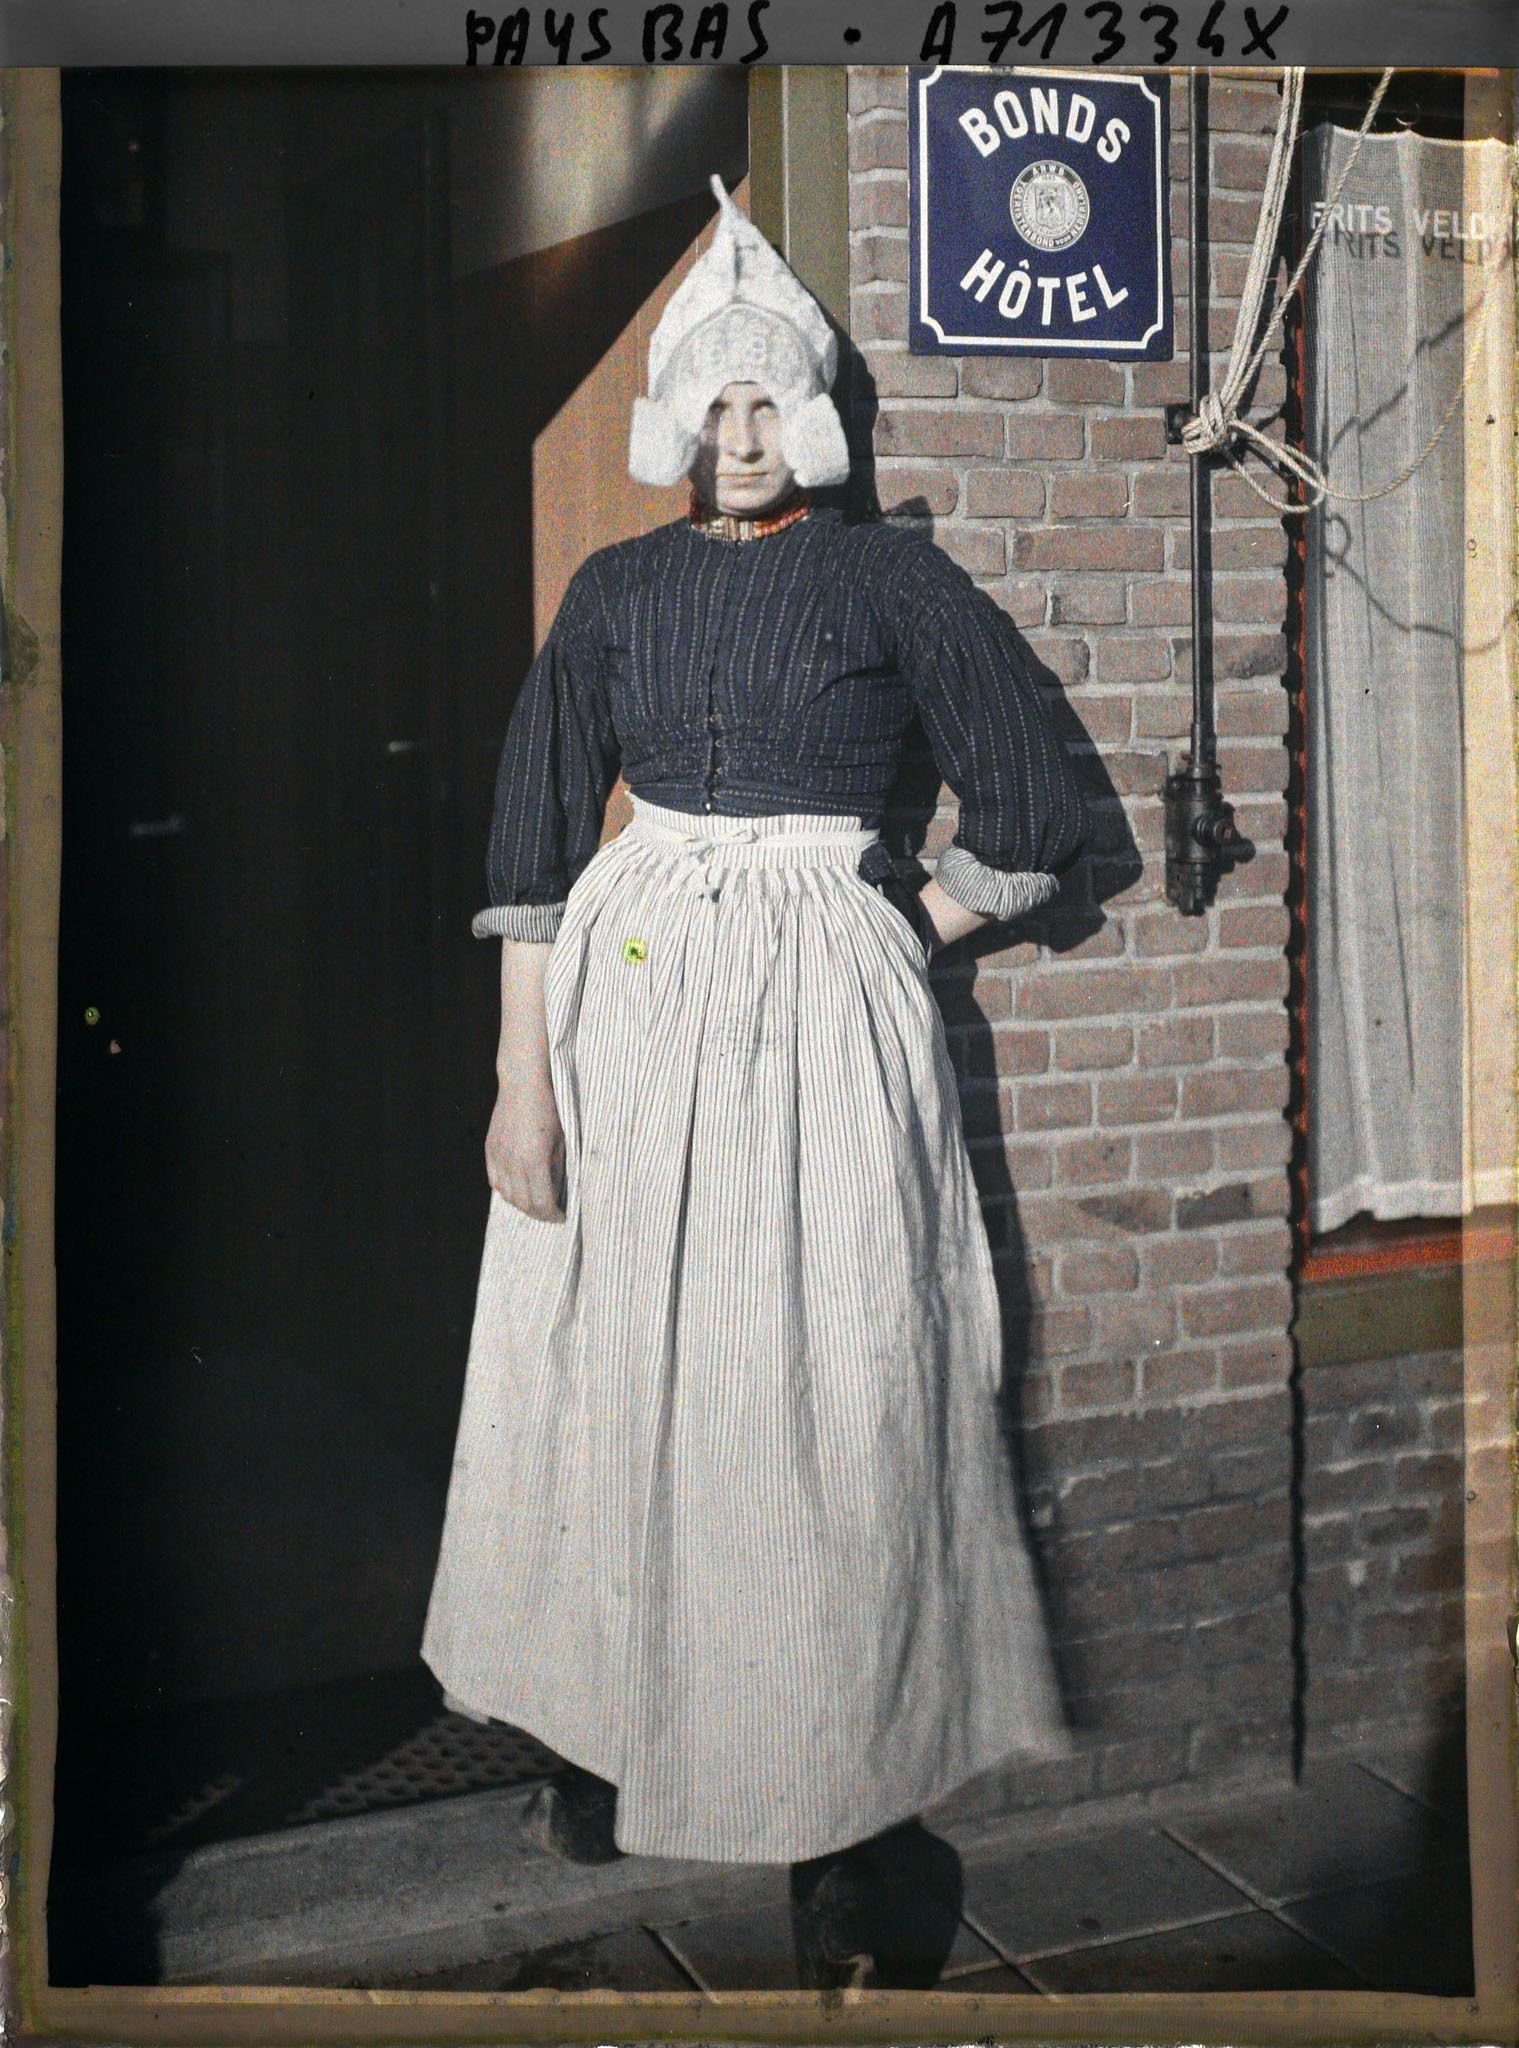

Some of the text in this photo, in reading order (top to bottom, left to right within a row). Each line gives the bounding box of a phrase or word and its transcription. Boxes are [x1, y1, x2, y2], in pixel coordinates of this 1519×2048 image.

[465, 9, 612, 64] PAYS
[642, 4, 772, 62] BAS
[958, 86, 1131, 164] BONDS
[1311, 201, 1393, 235] FRITS
[959, 247, 1130, 326] HÔTEL
